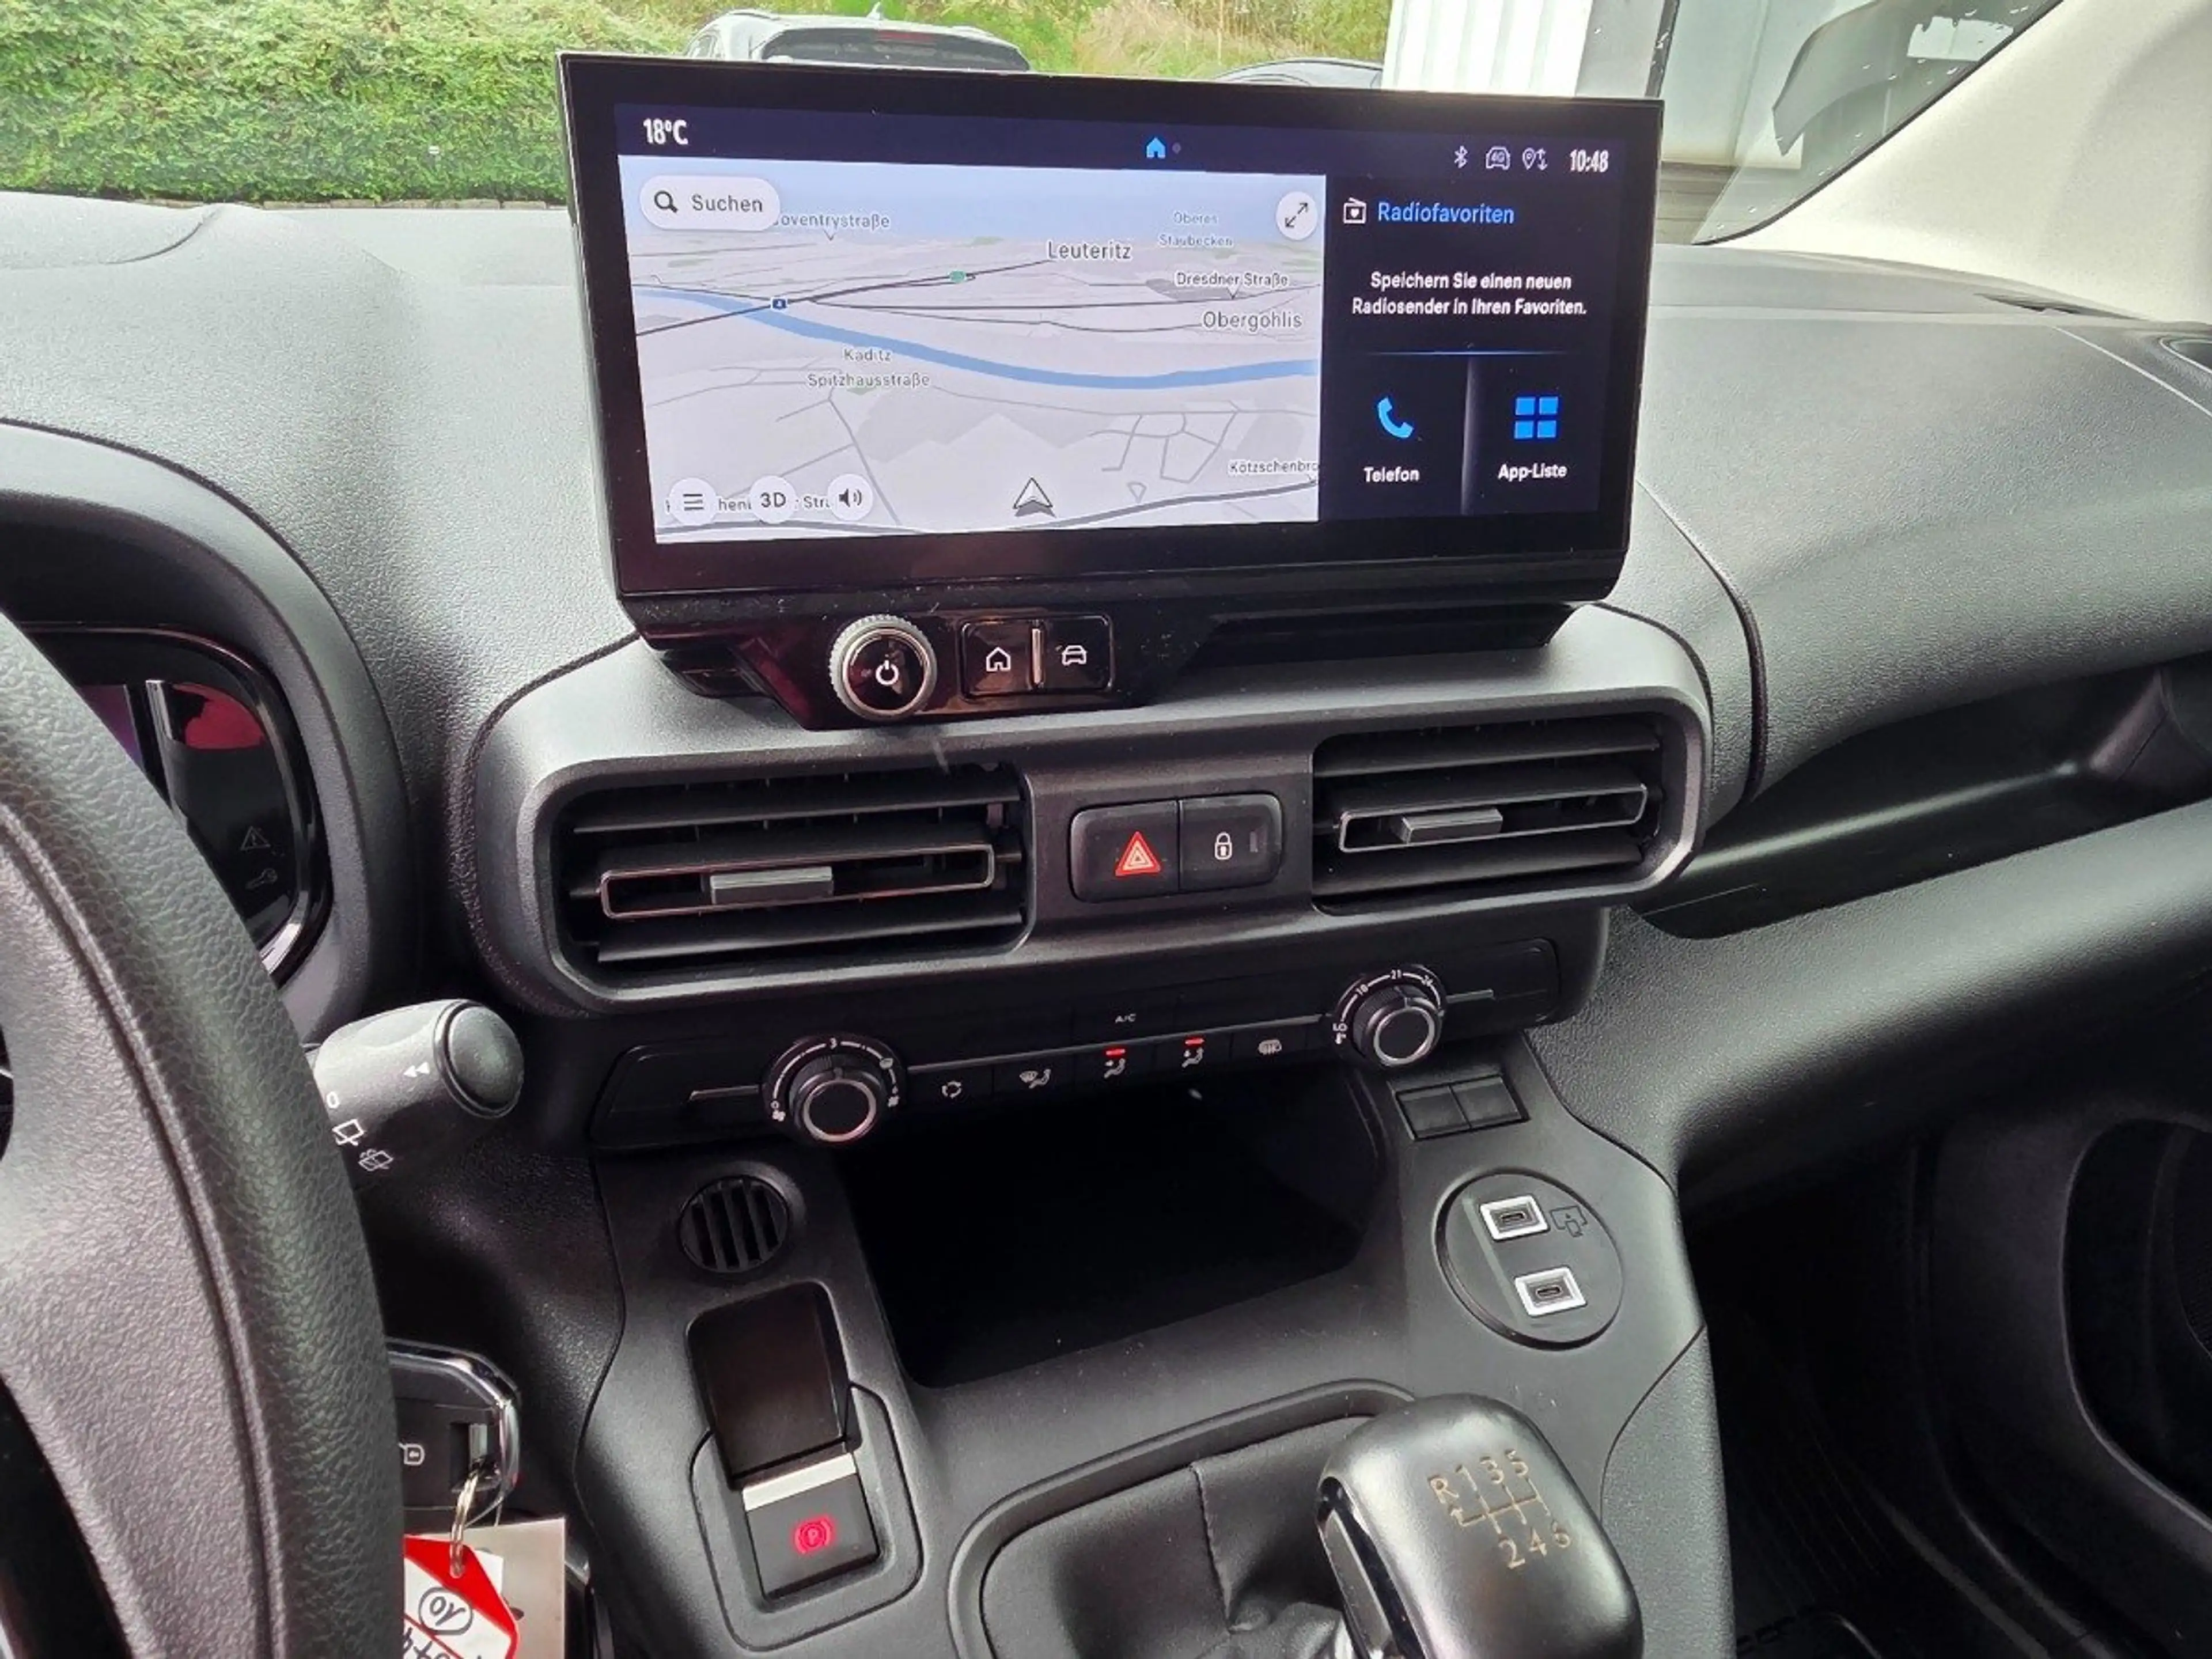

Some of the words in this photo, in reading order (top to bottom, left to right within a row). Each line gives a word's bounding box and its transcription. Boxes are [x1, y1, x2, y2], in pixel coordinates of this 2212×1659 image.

[643, 119, 689, 145] 18°C
[1569, 149, 1609, 172] 10:48
[691, 195, 763, 213] Suchen
[1377, 202, 1515, 225] Radiofavoriten
[1047, 242, 1131, 260] Leuteritz
[1176, 272, 1240, 286] Dresdner
[1244, 273, 1289, 287] Straße
[1370, 271, 1449, 291] Speichern
[1453, 272, 1478, 289] Sie
[1480, 272, 1522, 289] einen
[1526, 275, 1571, 290] neuen
[1352, 297, 1450, 315] Radiosender
[1453, 298, 1468, 315] in
[1471, 298, 1510, 315] Ihren
[1514, 298, 1587, 316] Favoriten.
[1203, 311, 1302, 332] Obergohlis
[843, 349, 892, 362] Kaditz
[807, 372, 930, 388] Spitzhausstraße
[1363, 467, 1420, 483] Telefon
[1497, 463, 1567, 482] App-Liste
[760, 492, 786, 508] 3D
[1115, 1013, 1137, 1024] A/C
[325, 1090, 340, 1109] 0
[1429, 1475, 1460, 1504] R
[1479, 1456, 1505, 1484] 3
[1504, 1449, 1529, 1478] 5
[1499, 1536, 1526, 1569] 2
[1529, 1527, 1548, 1557] 4
